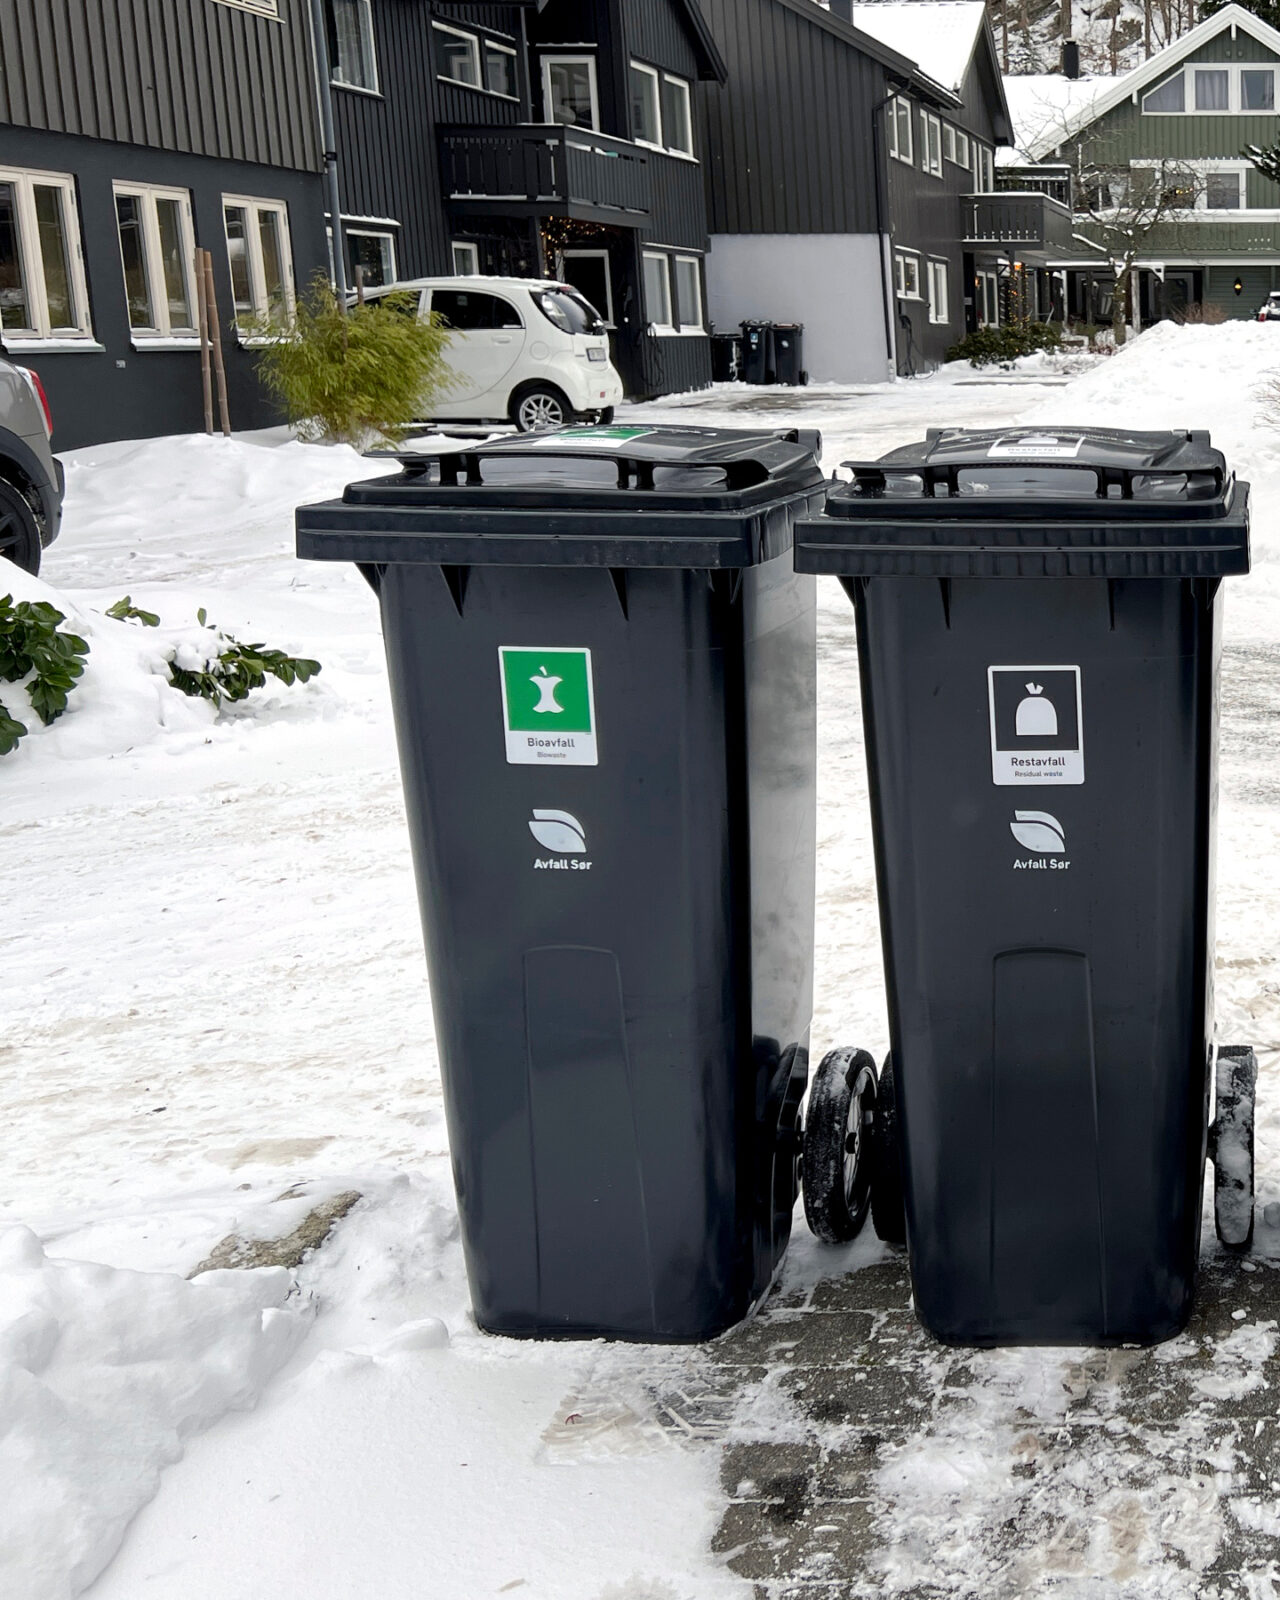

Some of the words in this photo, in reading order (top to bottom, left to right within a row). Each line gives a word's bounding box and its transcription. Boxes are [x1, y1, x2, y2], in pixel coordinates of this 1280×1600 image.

[527, 737, 575, 748] Bioavfall
[1010, 756, 1066, 767] Restavfall
[533, 858, 569, 869] Avfall
[1013, 858, 1048, 869] Avfall
[1049, 858, 1071, 869] Sør
